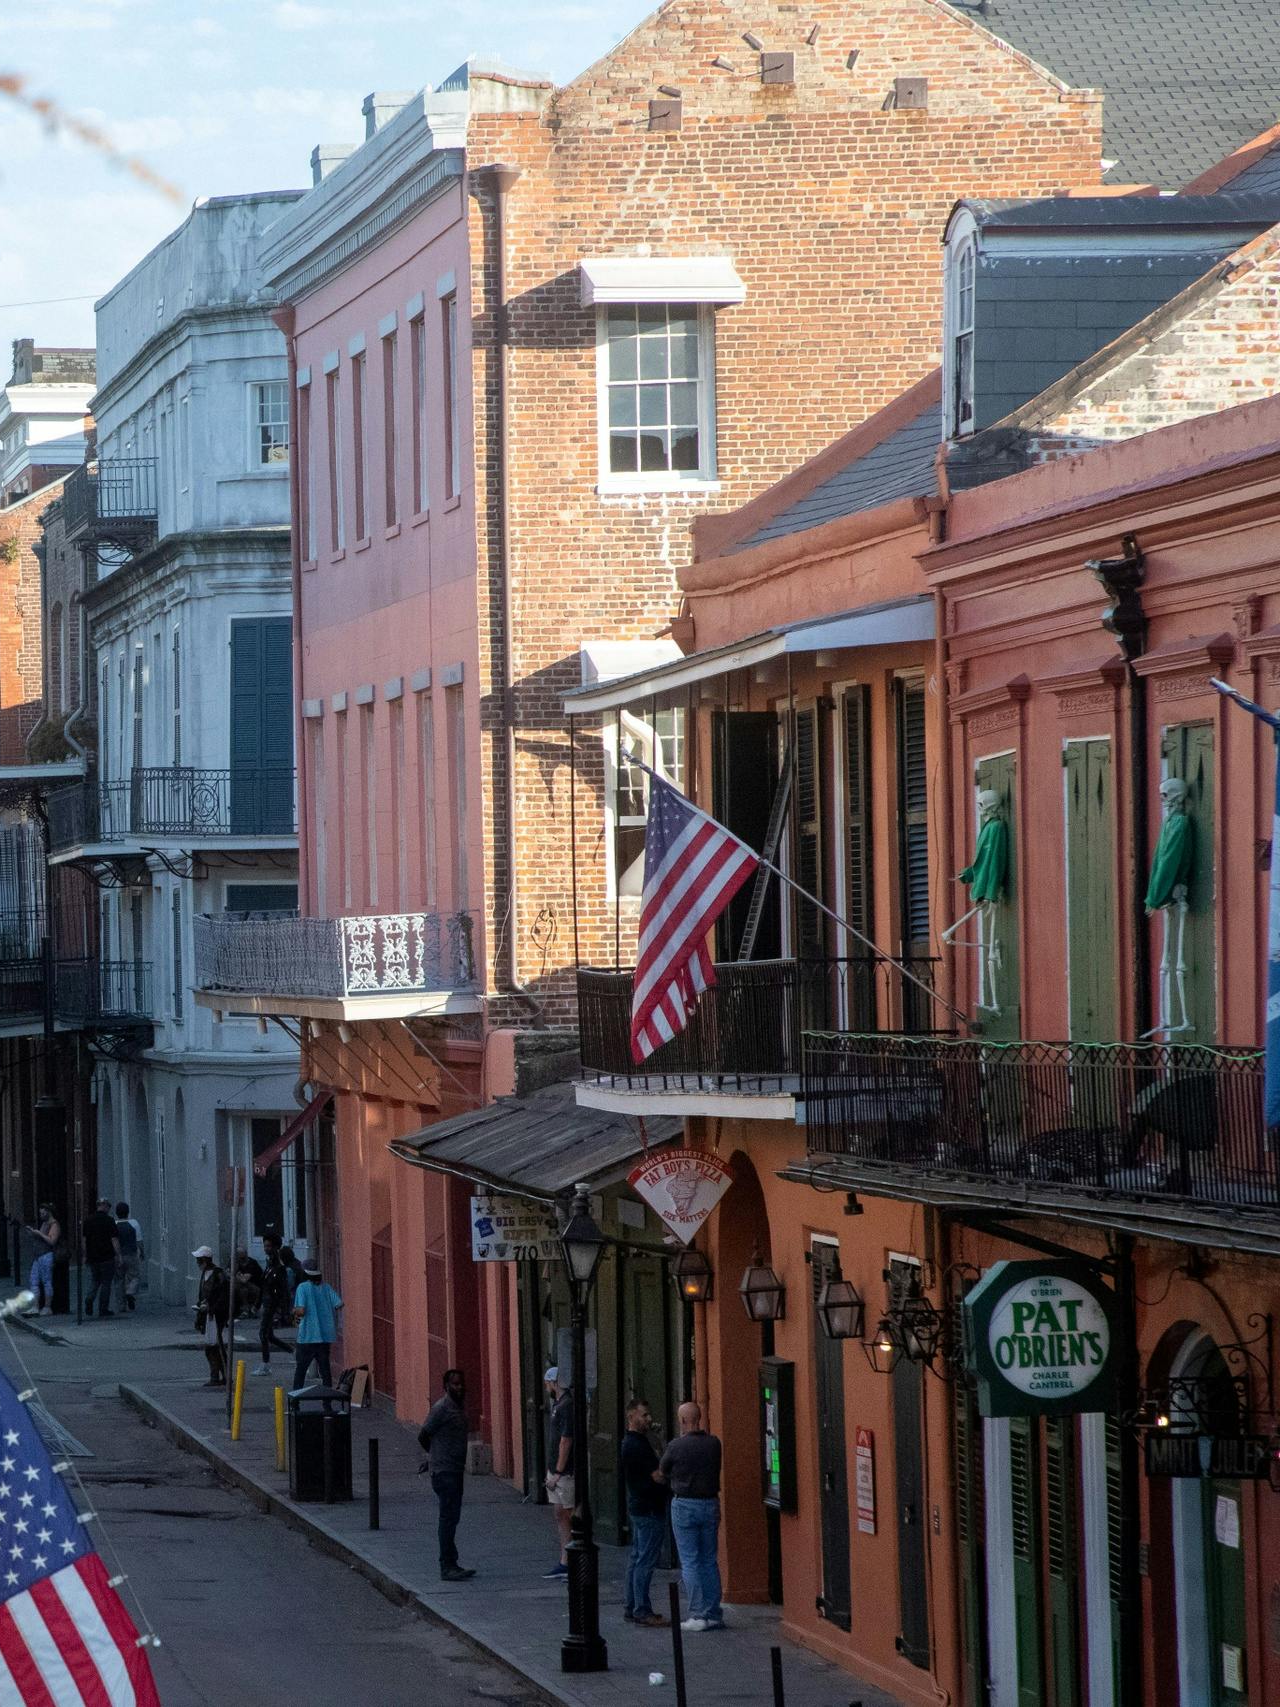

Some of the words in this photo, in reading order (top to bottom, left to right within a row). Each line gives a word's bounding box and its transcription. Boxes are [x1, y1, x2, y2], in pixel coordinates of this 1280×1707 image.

[639, 1153, 669, 1173] WORLD'S
[670, 1150, 701, 1159] BIGGEST
[643, 1168, 661, 1186] FAT
[662, 1160, 690, 1175] BOY'S
[695, 1161, 723, 1184] PIZZA
[496, 1217, 515, 1226] BIG
[518, 1216, 543, 1226] EASY
[662, 1210, 678, 1222] SIZE
[679, 1208, 709, 1223] MATTERS
[513, 1245, 538, 1261] 710
[1031, 1288, 1063, 1297] O'BRIEN
[1011, 1300, 1083, 1333] PAT
[995, 1331, 1104, 1369] O'BRIEN'S
[1032, 1371, 1071, 1380] CHARLIE
[1029, 1381, 1075, 1390] CANTRELL
[1150, 1438, 1197, 1473] MINT
